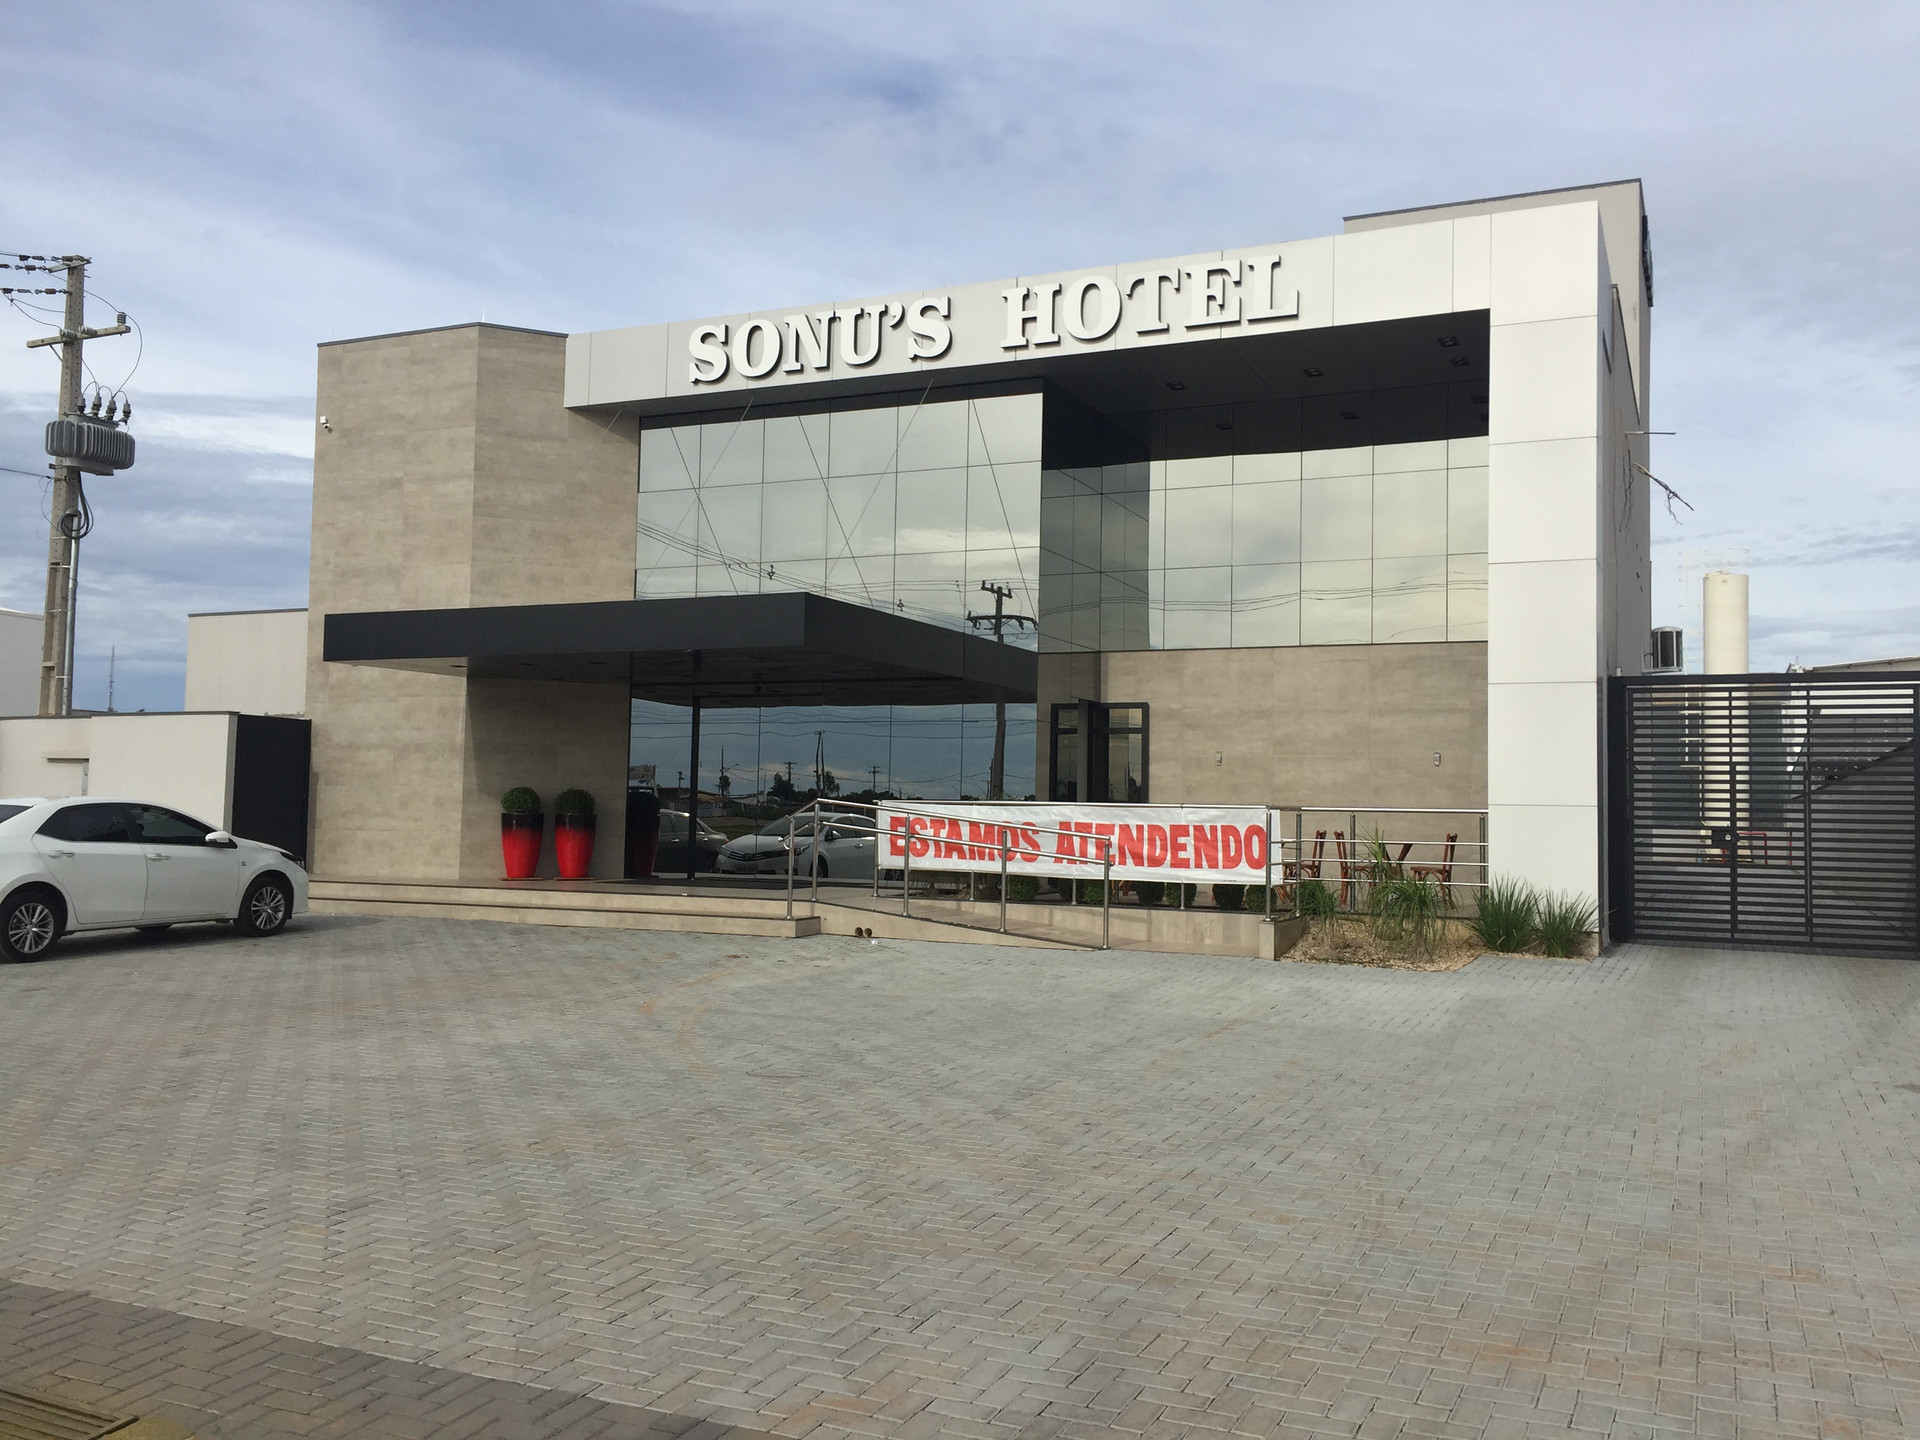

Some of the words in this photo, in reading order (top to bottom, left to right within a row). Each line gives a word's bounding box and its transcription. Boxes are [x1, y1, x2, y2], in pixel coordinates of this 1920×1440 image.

[688, 296, 952, 384] SONU'S
[1001, 254, 1299, 349] HOTEL
[890, 816, 1041, 863] ESTAMOS
[1054, 821, 1267, 870] ATENDENDO
